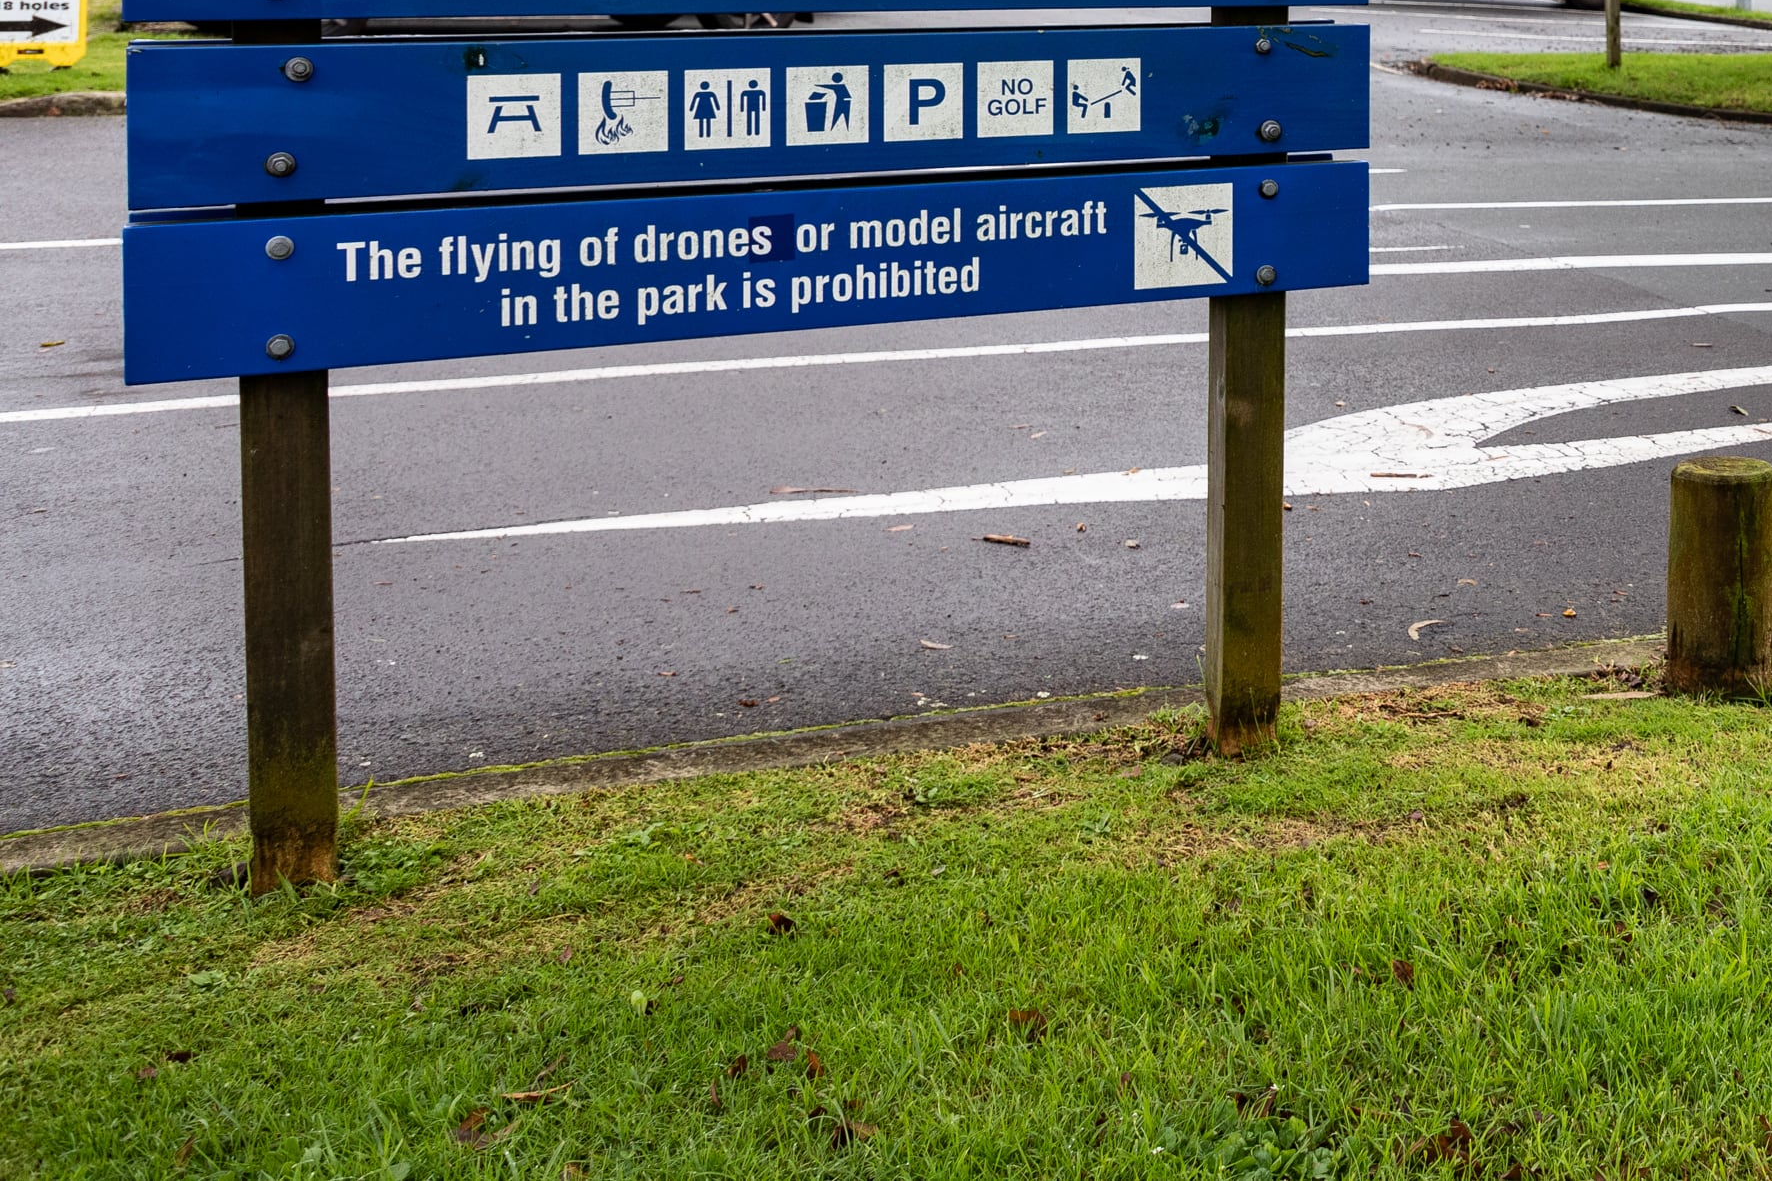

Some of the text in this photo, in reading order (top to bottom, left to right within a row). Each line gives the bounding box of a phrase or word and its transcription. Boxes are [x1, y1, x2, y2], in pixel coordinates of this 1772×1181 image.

[0, 1, 70, 11] 8 holes
[908, 78, 946, 126] P
[1001, 78, 1034, 95] NO
[987, 98, 1047, 116] GOLF
[336, 200, 1107, 283] The flying of drones or model aircraft
[501, 256, 980, 327] in the park is prohibited
